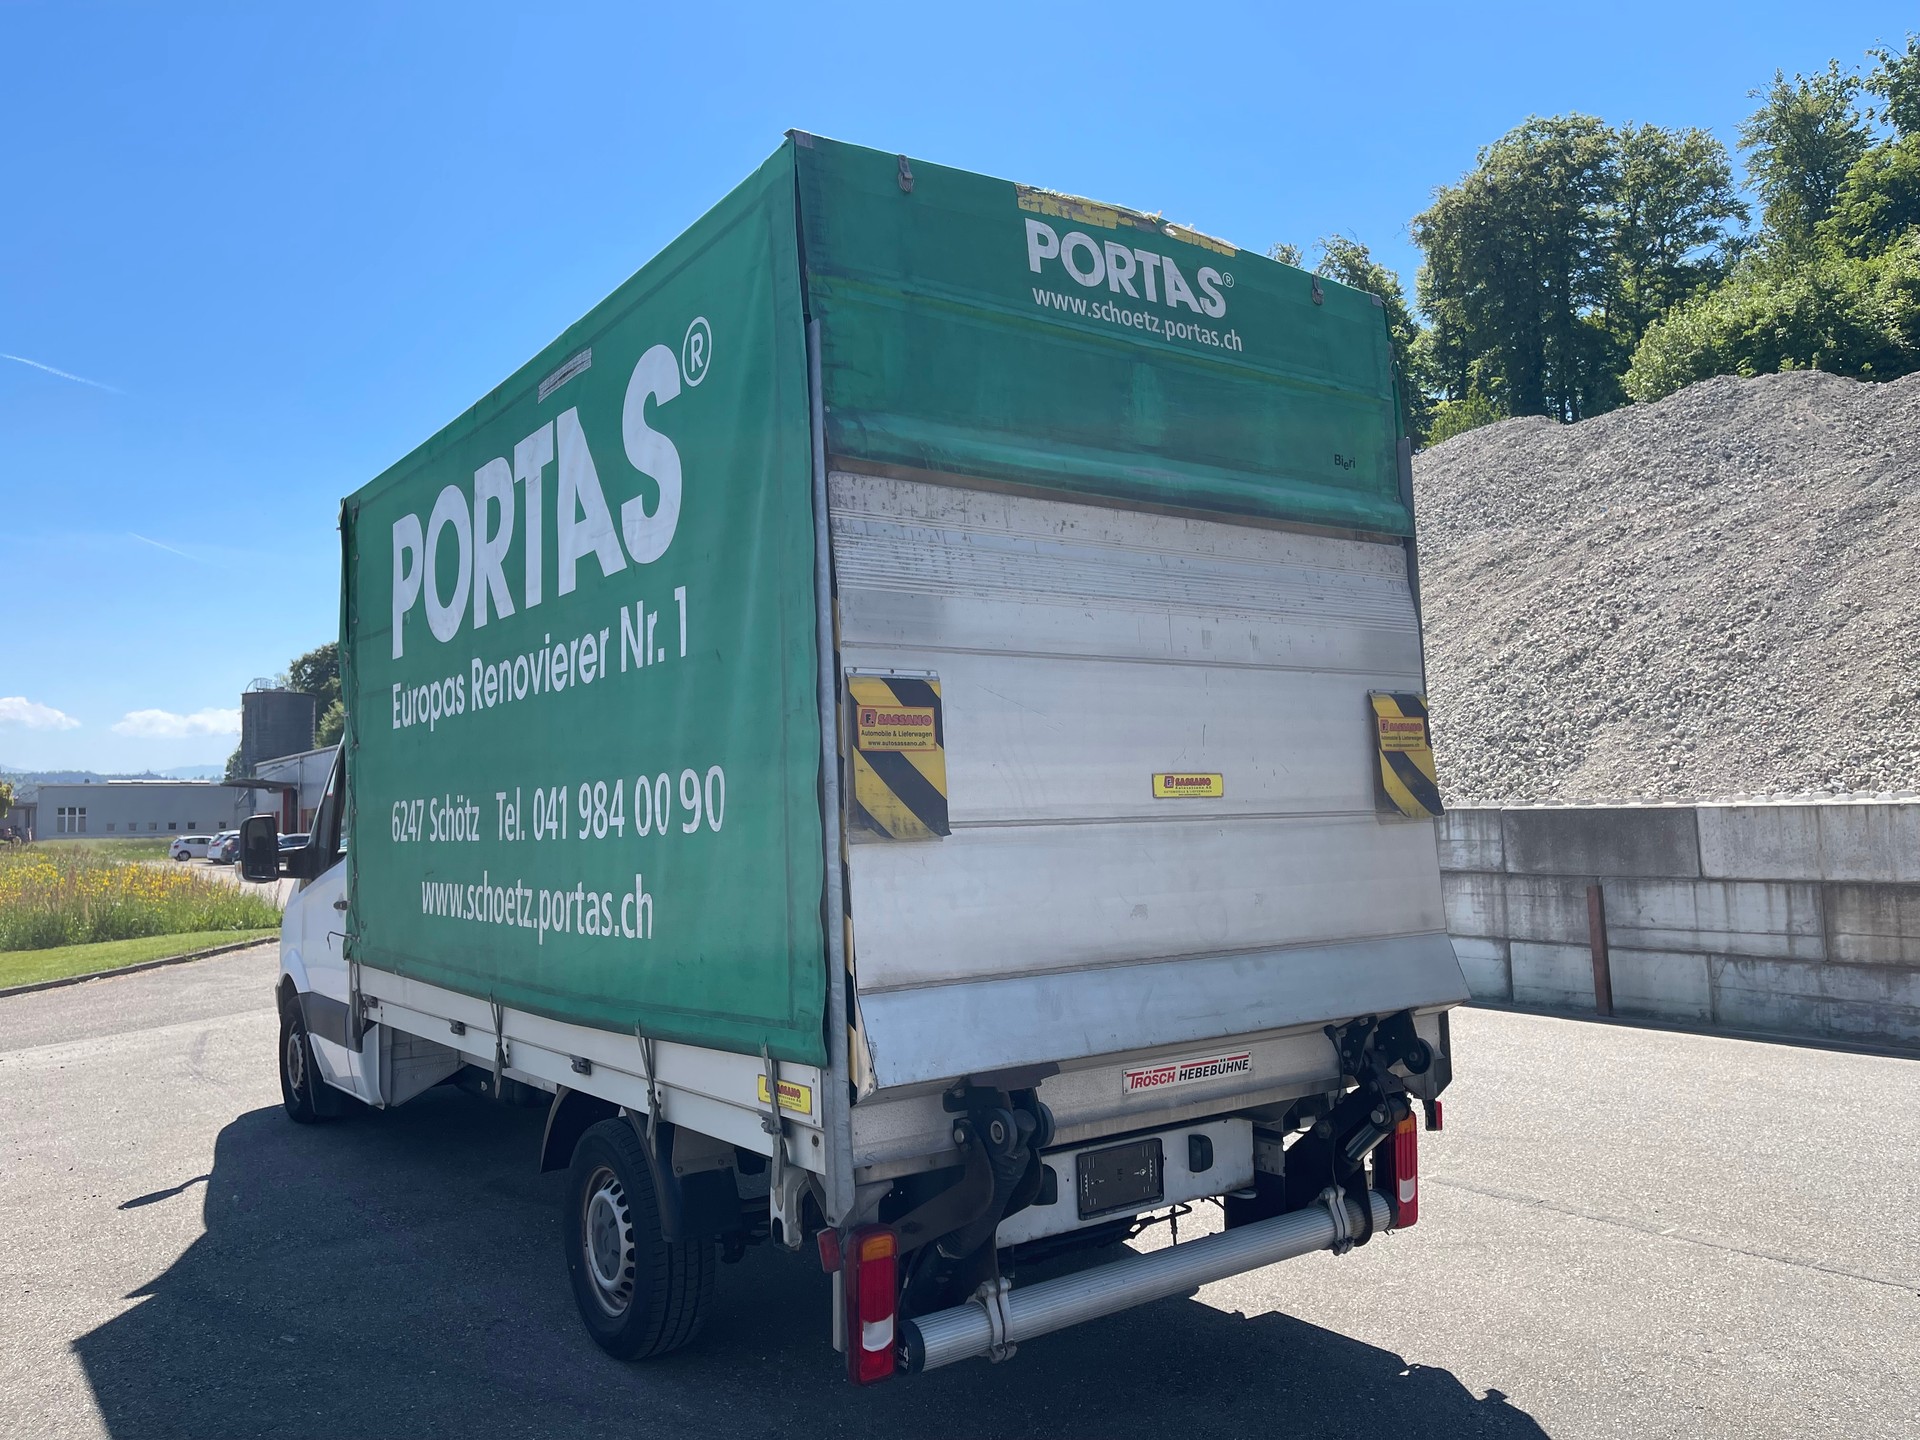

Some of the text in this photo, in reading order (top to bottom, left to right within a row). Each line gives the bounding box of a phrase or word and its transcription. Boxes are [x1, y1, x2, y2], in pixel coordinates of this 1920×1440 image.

[1031, 287, 1243, 352] www.schoetz.portas.ch
[1334, 453, 1356, 471] Bieri
[391, 585, 688, 732] Europas Renovierer Nr. 1
[878, 714, 932, 726] SASSANO
[391, 765, 726, 842] 6247 Schötz Tel. 041 984 00 90
[421, 870, 653, 945] www.schoetz.portas.ch
[1126, 1058, 1249, 1090] TRÖSCH HEBEBÜHNE
